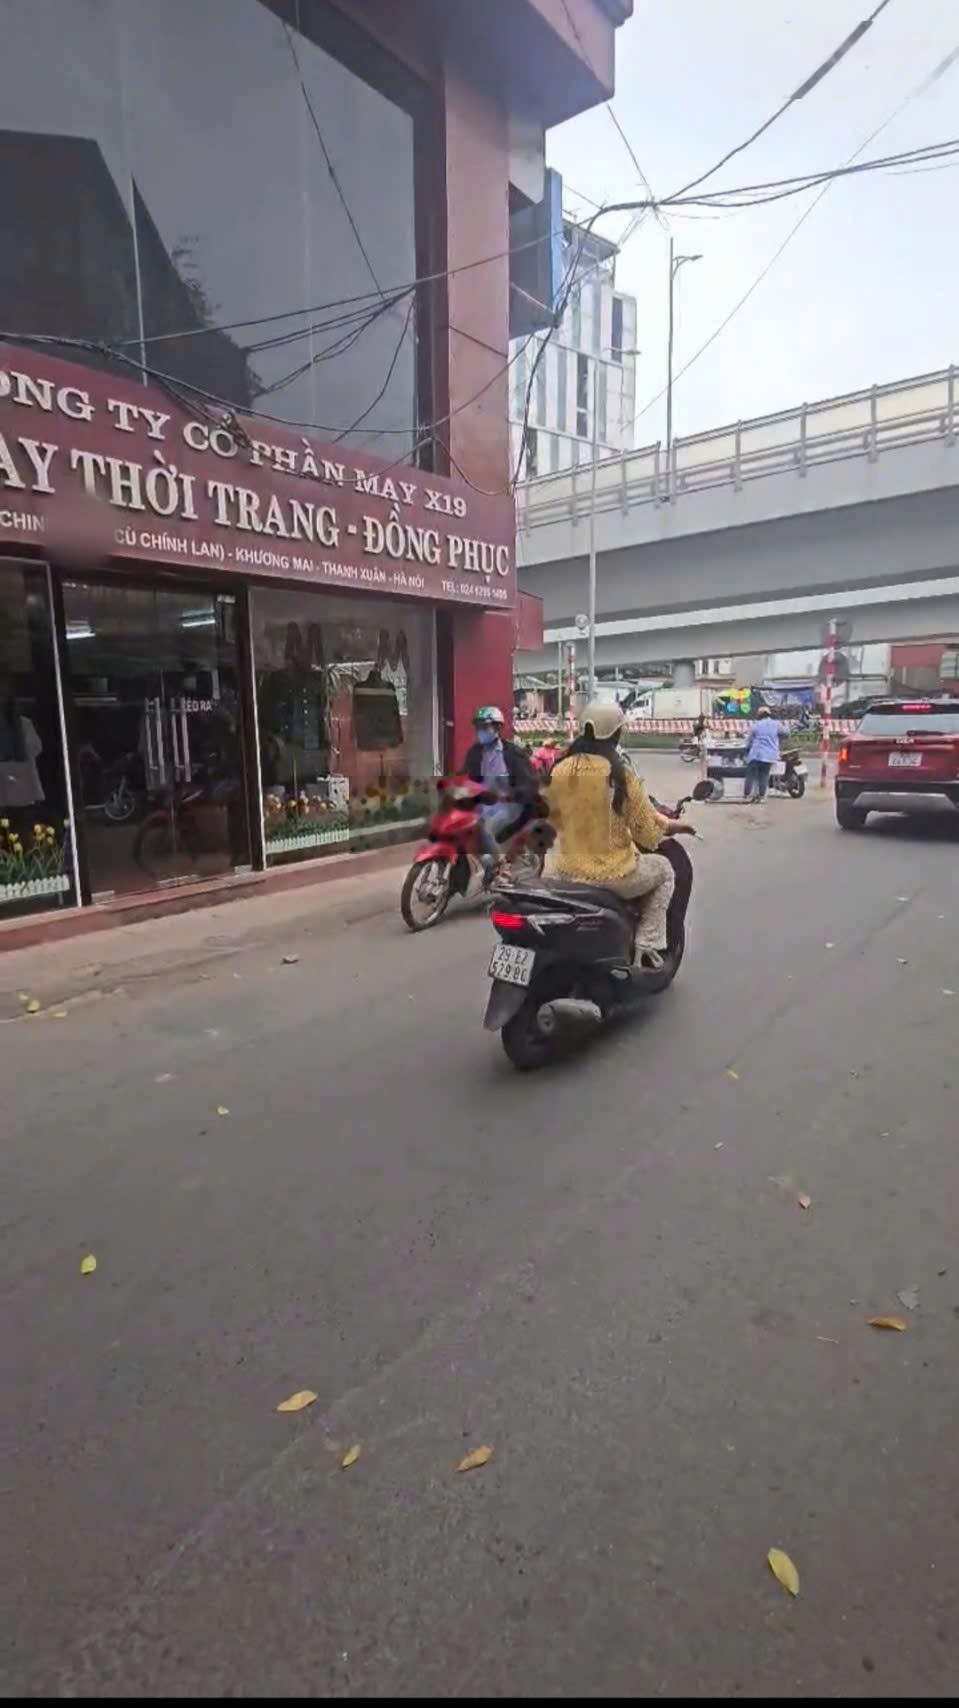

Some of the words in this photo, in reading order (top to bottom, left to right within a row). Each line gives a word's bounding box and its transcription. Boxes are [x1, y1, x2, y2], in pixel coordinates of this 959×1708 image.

[70, 449, 199, 521] THỜI
[207, 480, 340, 547] TRANG
[363, 502, 441, 565] ĐỒNG
[447, 535, 510, 583] PHỤC
[107, 398, 171, 440] TY
[250, 437, 345, 487] PHẦN
[354, 468, 418, 505] MAY
[424, 488, 467, 518] X19
[140, 532, 188, 555] CHÍNH
[191, 540, 225, 561] LAN)
[235, 547, 290, 569] KHƯƠNG
[322, 562, 358, 579] THANH
